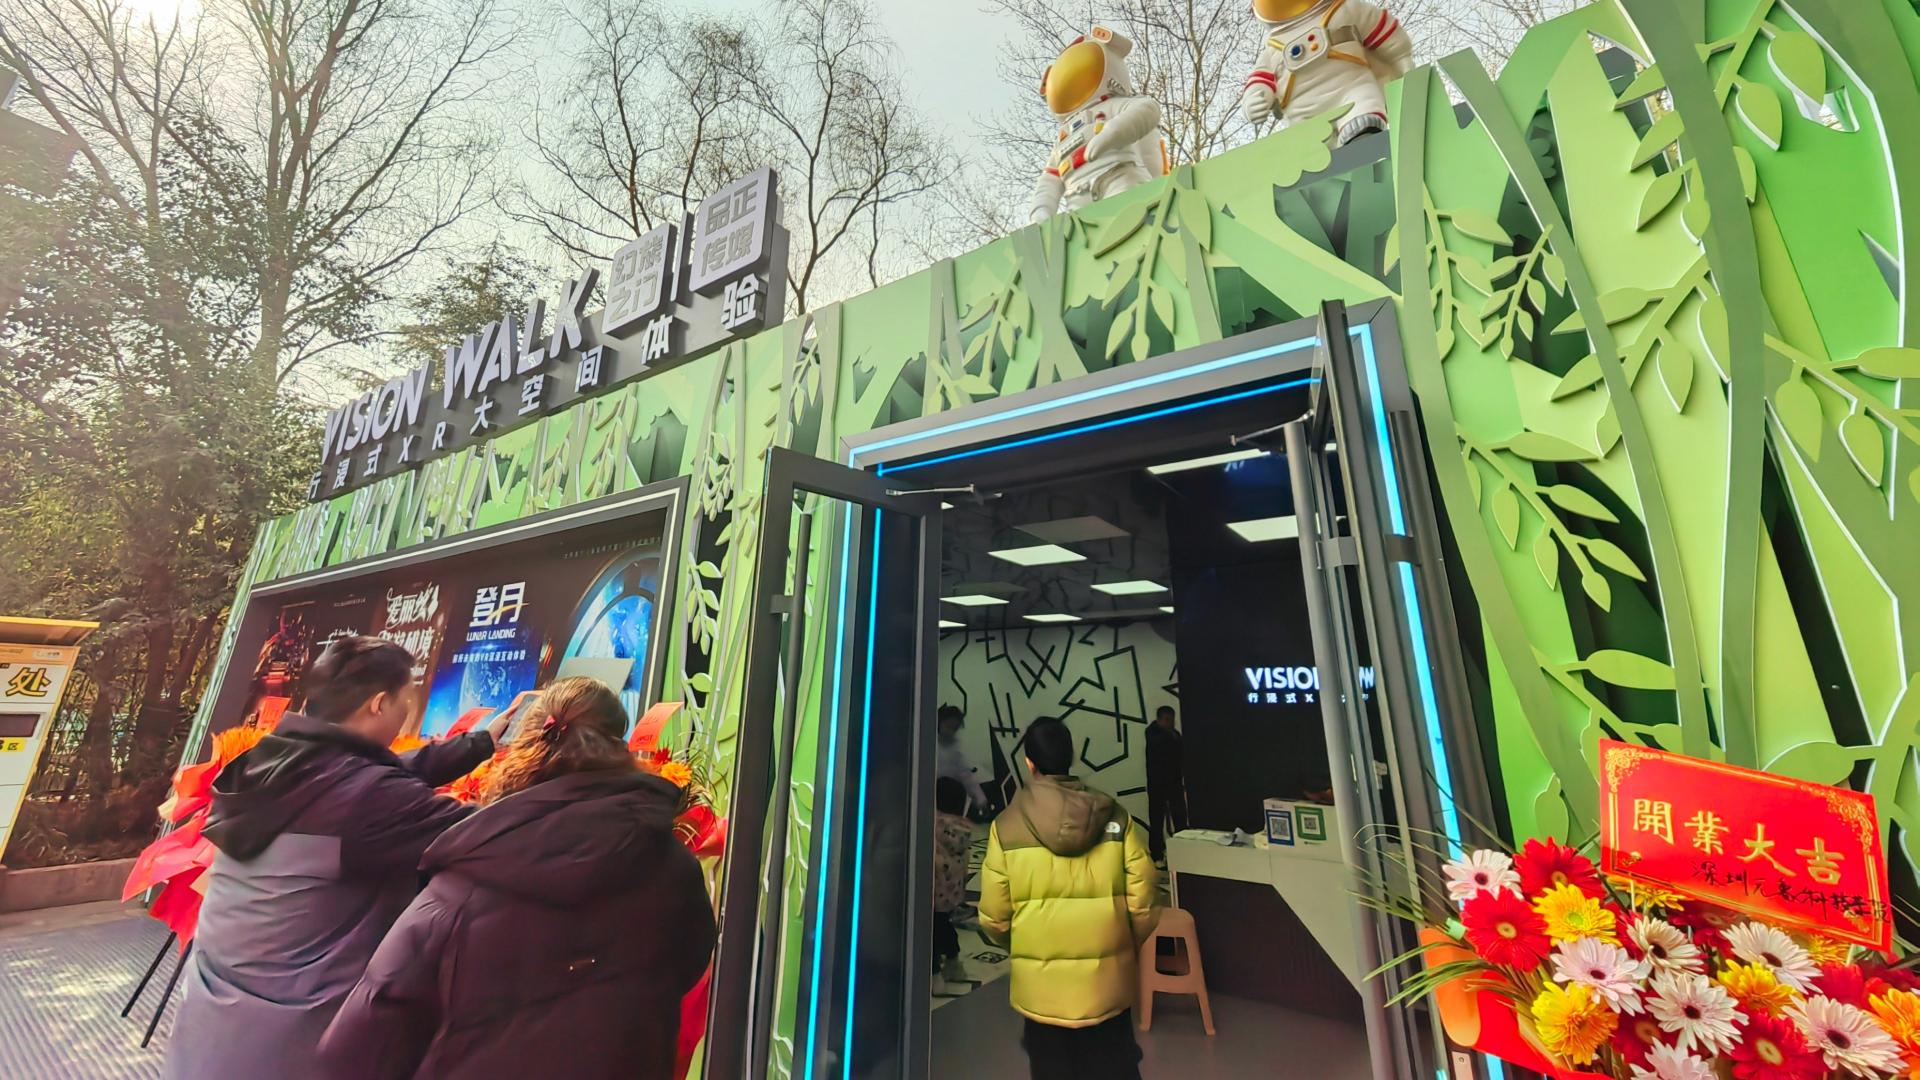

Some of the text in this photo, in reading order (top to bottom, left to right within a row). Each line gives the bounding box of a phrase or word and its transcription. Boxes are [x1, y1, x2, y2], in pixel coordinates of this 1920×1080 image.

[705, 179, 758, 236] 品正
[701, 221, 754, 278] 传媒
[609, 270, 658, 323] 之门
[321, 268, 598, 464] VISION WALK
[469, 582, 526, 627] 登月
[466, 628, 517, 641] LUNAR LANDING
[5, 667, 52, 697] 处
[1633, 798, 1845, 885] 開業大吉
